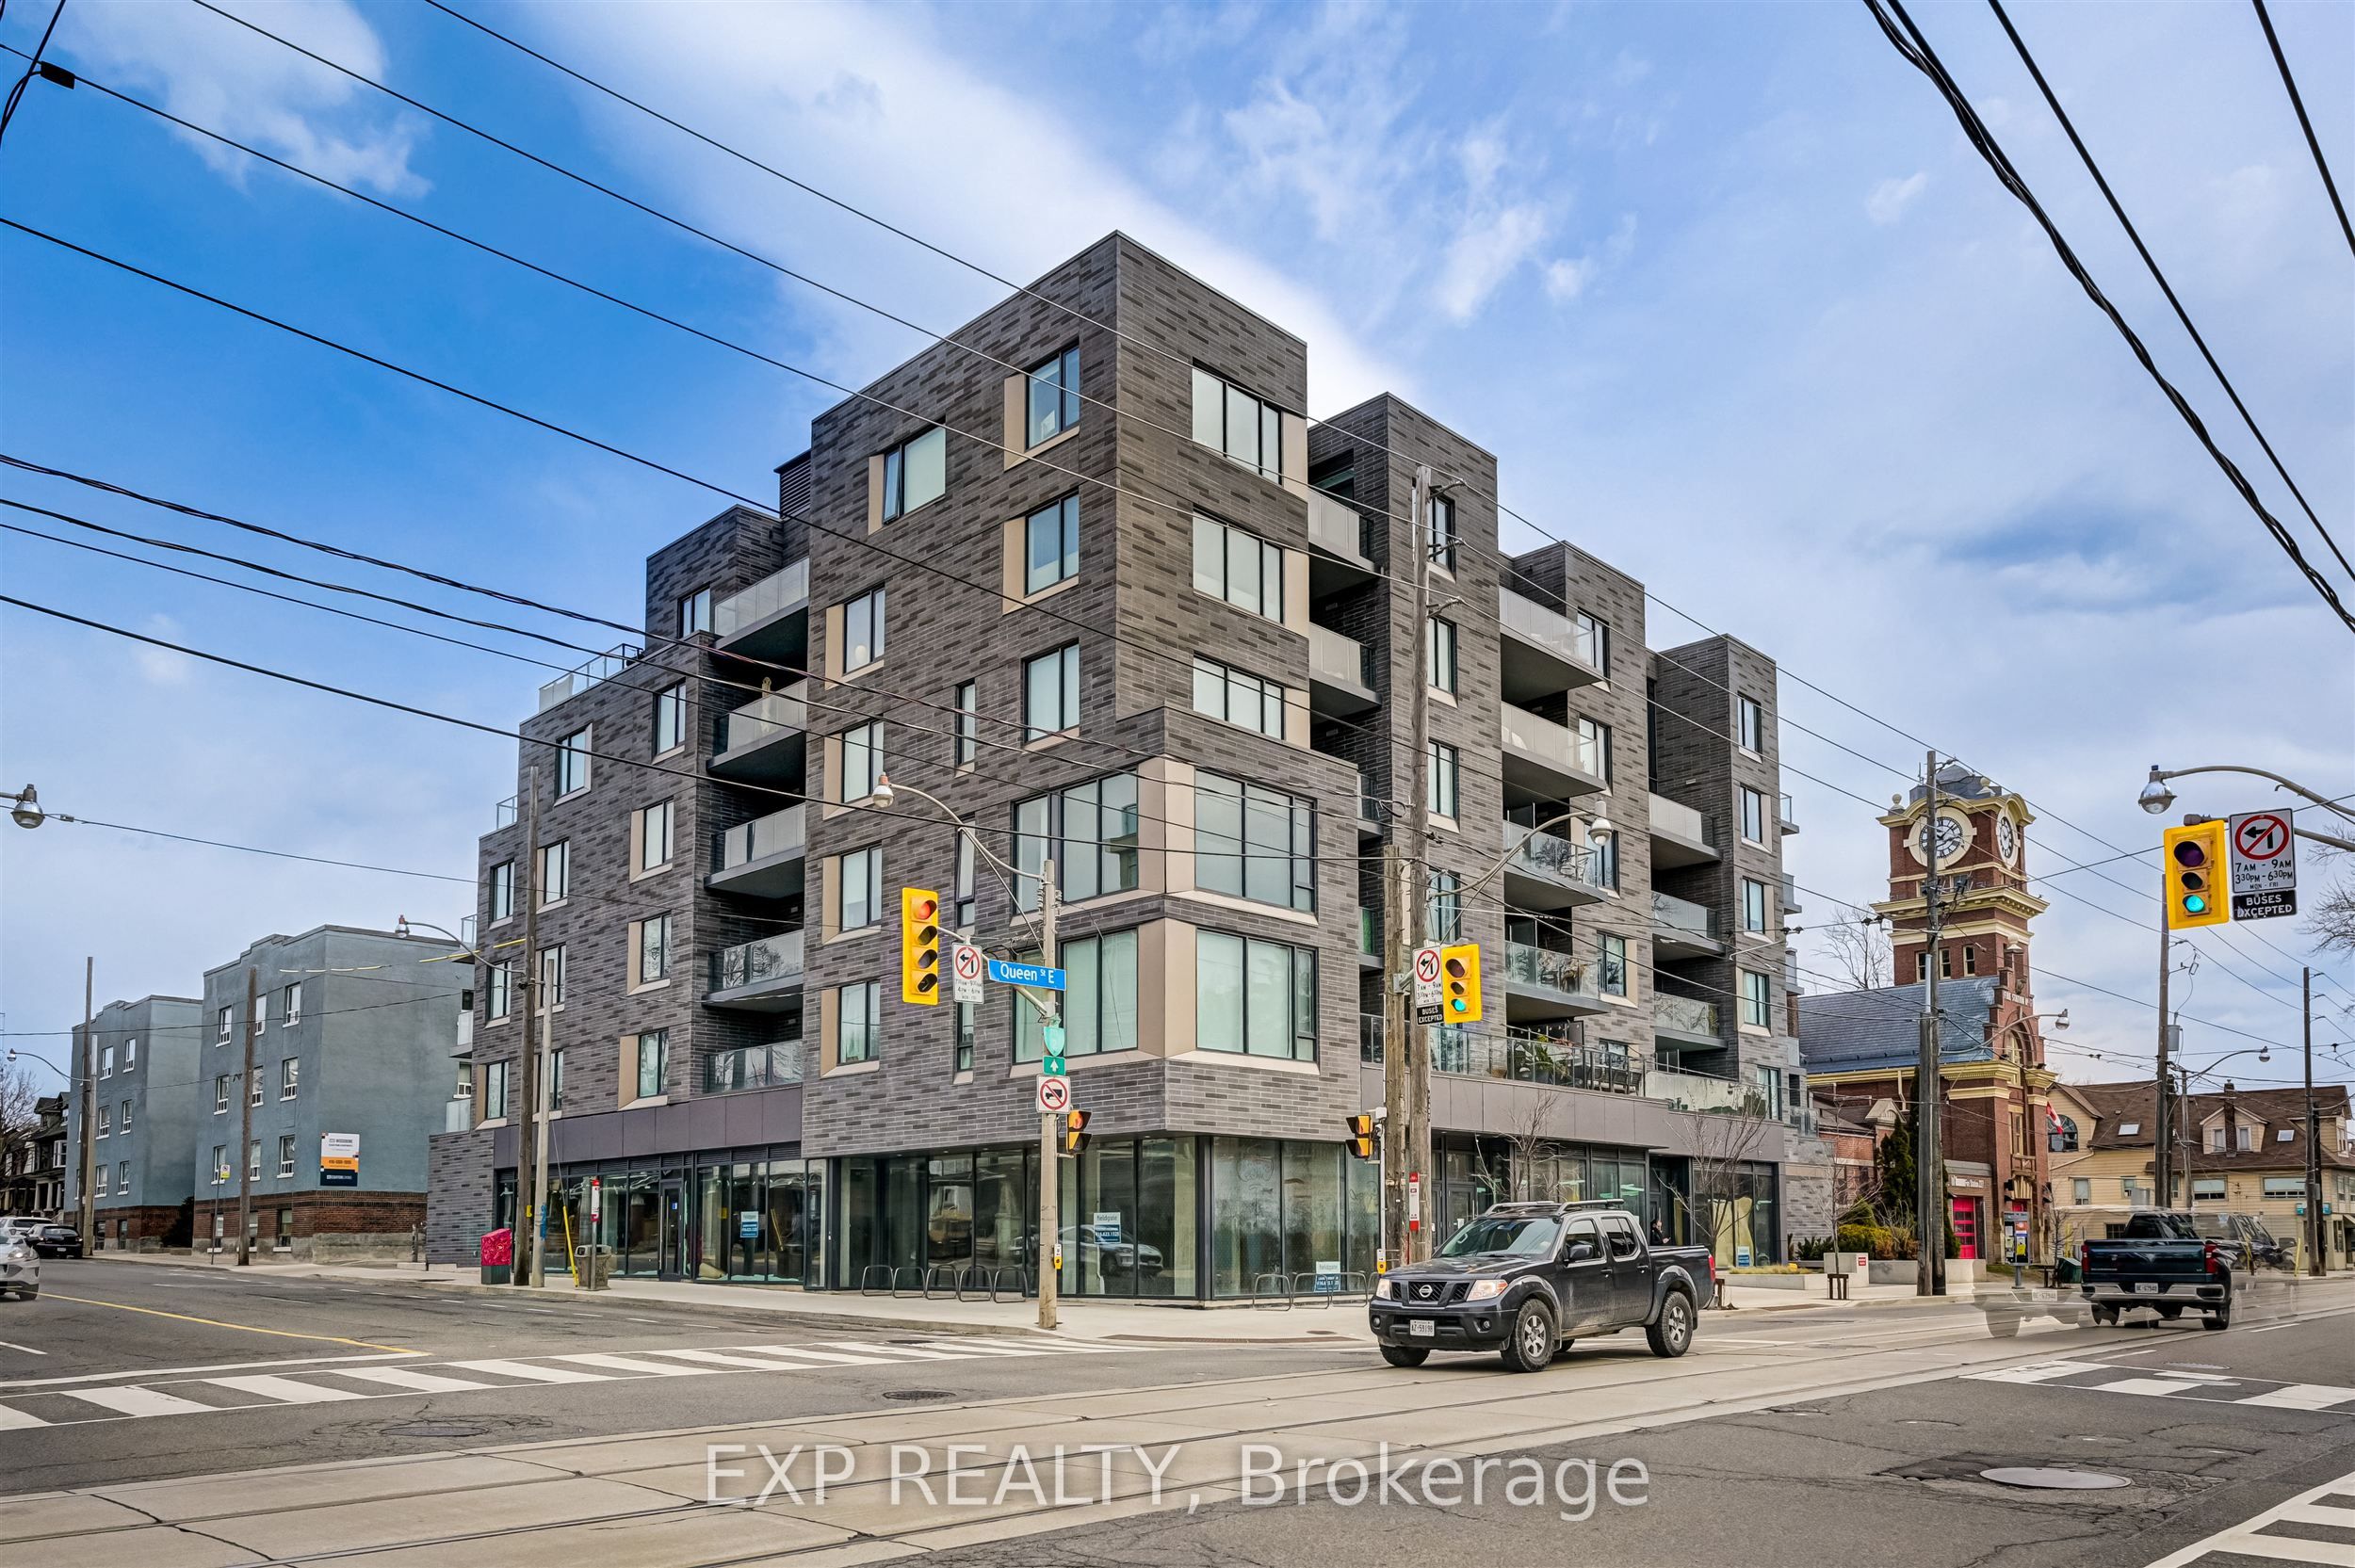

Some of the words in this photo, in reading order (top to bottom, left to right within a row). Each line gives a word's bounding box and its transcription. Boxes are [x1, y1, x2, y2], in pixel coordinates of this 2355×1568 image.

[2271, 859, 2292, 868] 9AM
[2246, 894, 2282, 906] BUSES
[999, 962, 1038, 981] Queen
[1048, 969, 1055, 984] E
[1421, 1007, 1438, 1015] BUSES
[1418, 1013, 1443, 1024] EXCEPTED
